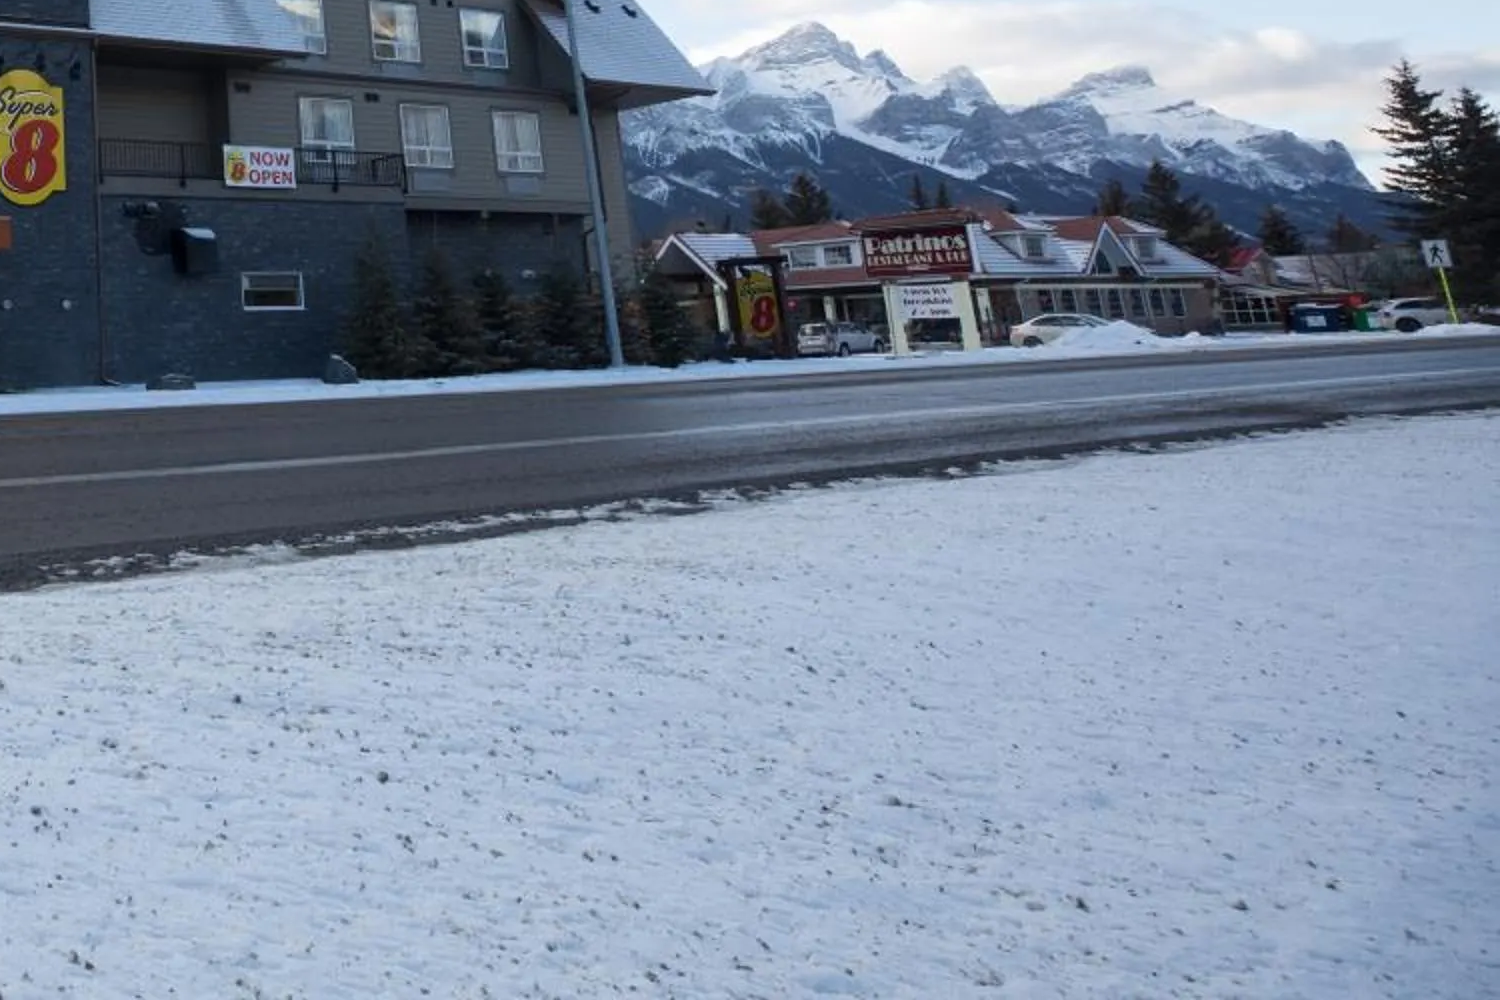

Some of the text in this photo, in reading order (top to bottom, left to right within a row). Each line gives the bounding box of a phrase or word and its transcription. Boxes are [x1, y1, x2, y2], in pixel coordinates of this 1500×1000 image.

[0, 119, 60, 194] 8
[250, 151, 290, 167] NOW
[250, 169, 293, 185] OPEN
[751, 294, 777, 334] 8
